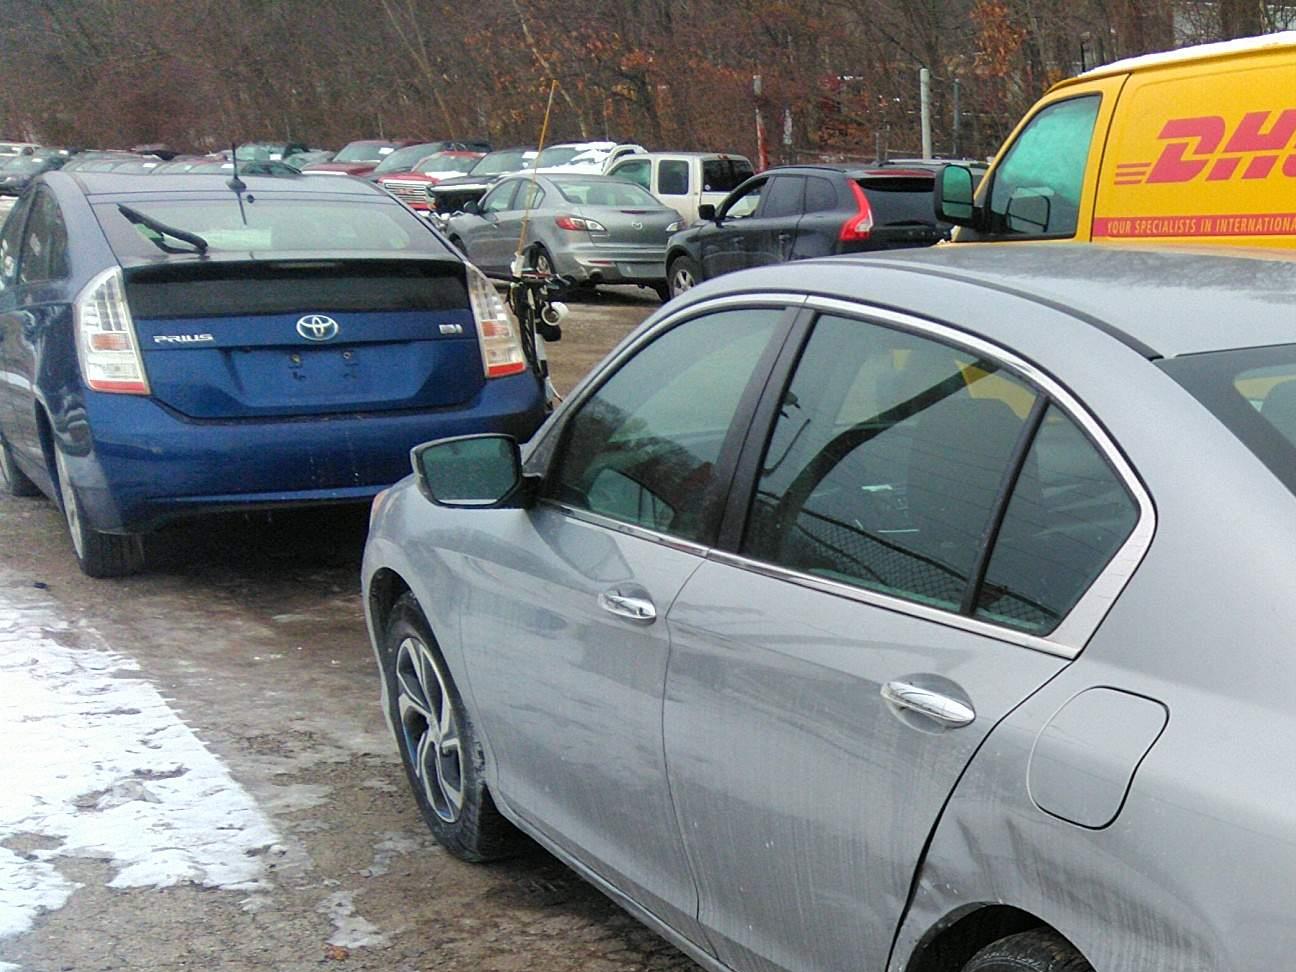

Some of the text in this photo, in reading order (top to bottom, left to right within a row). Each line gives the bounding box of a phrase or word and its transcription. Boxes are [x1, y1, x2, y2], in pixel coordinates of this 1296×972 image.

[1107, 220, 1131, 234] YOUR
[1135, 218, 1196, 234] SPECIALISTS
[1200, 218, 1211, 233] IN
[153, 333, 214, 343] PRIUS
